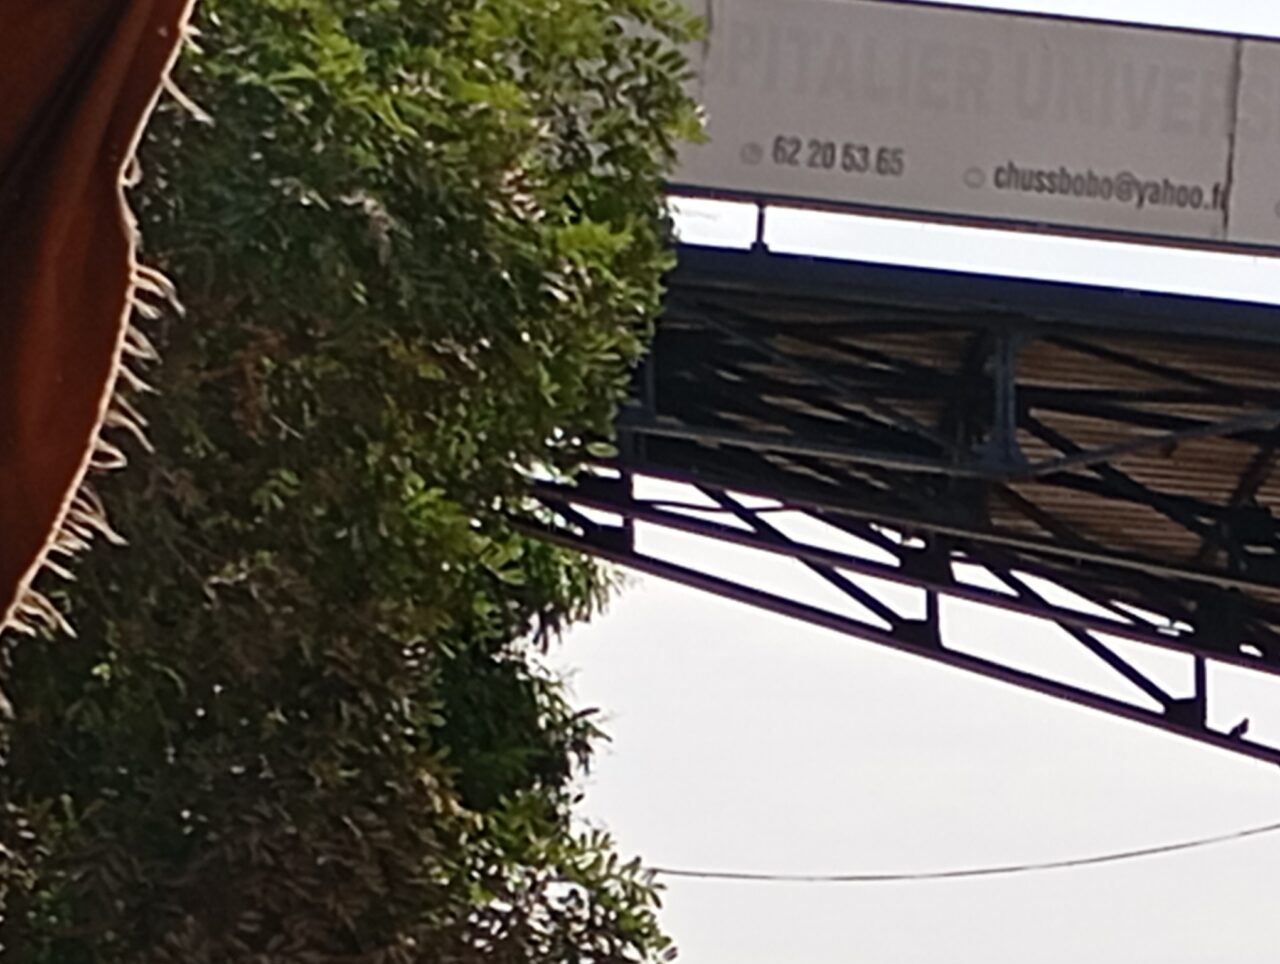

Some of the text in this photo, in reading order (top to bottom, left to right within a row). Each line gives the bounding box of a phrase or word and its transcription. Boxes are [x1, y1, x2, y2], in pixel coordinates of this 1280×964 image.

[724, 19, 993, 116] PITALIER
[771, 134, 905, 177] 62 20 53 65
